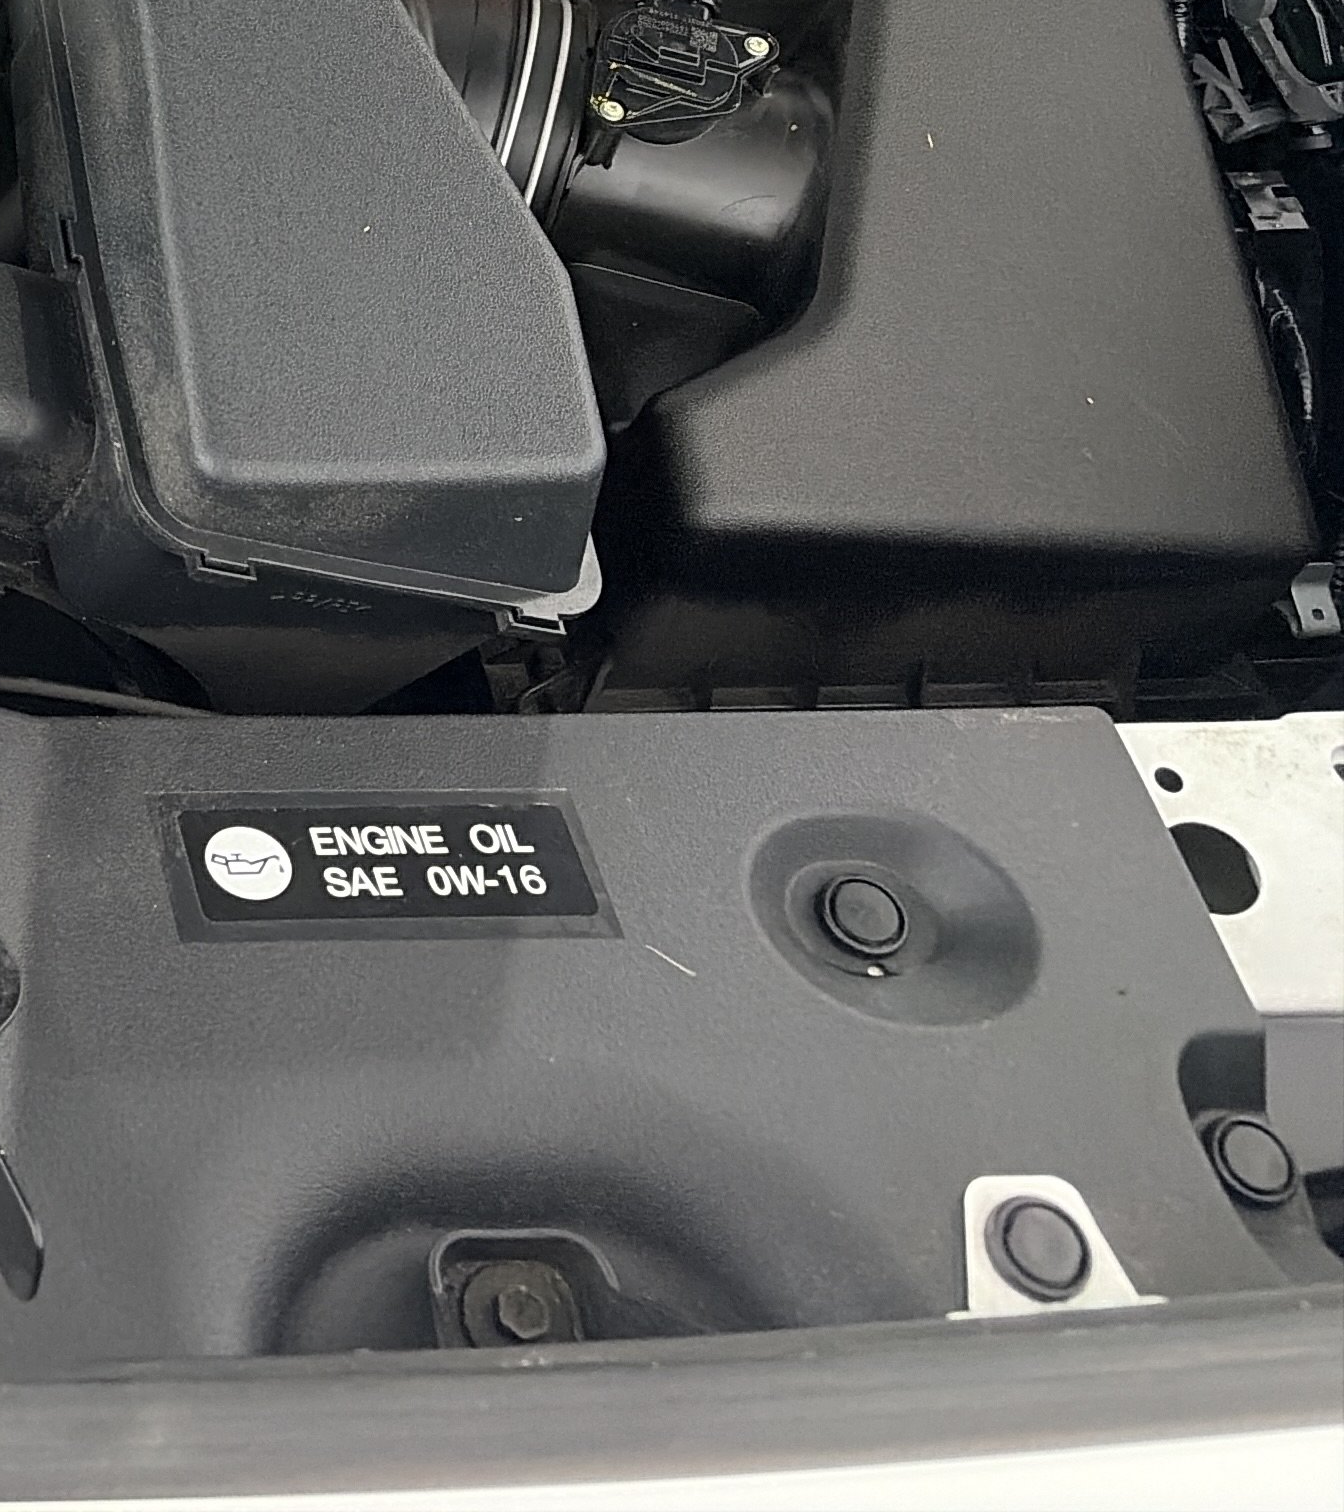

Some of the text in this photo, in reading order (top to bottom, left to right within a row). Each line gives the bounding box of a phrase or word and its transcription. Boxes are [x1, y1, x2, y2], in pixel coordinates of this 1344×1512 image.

[309, 822, 534, 856] ENGINE OIL
[323, 864, 548, 898] SAE 0W-16
